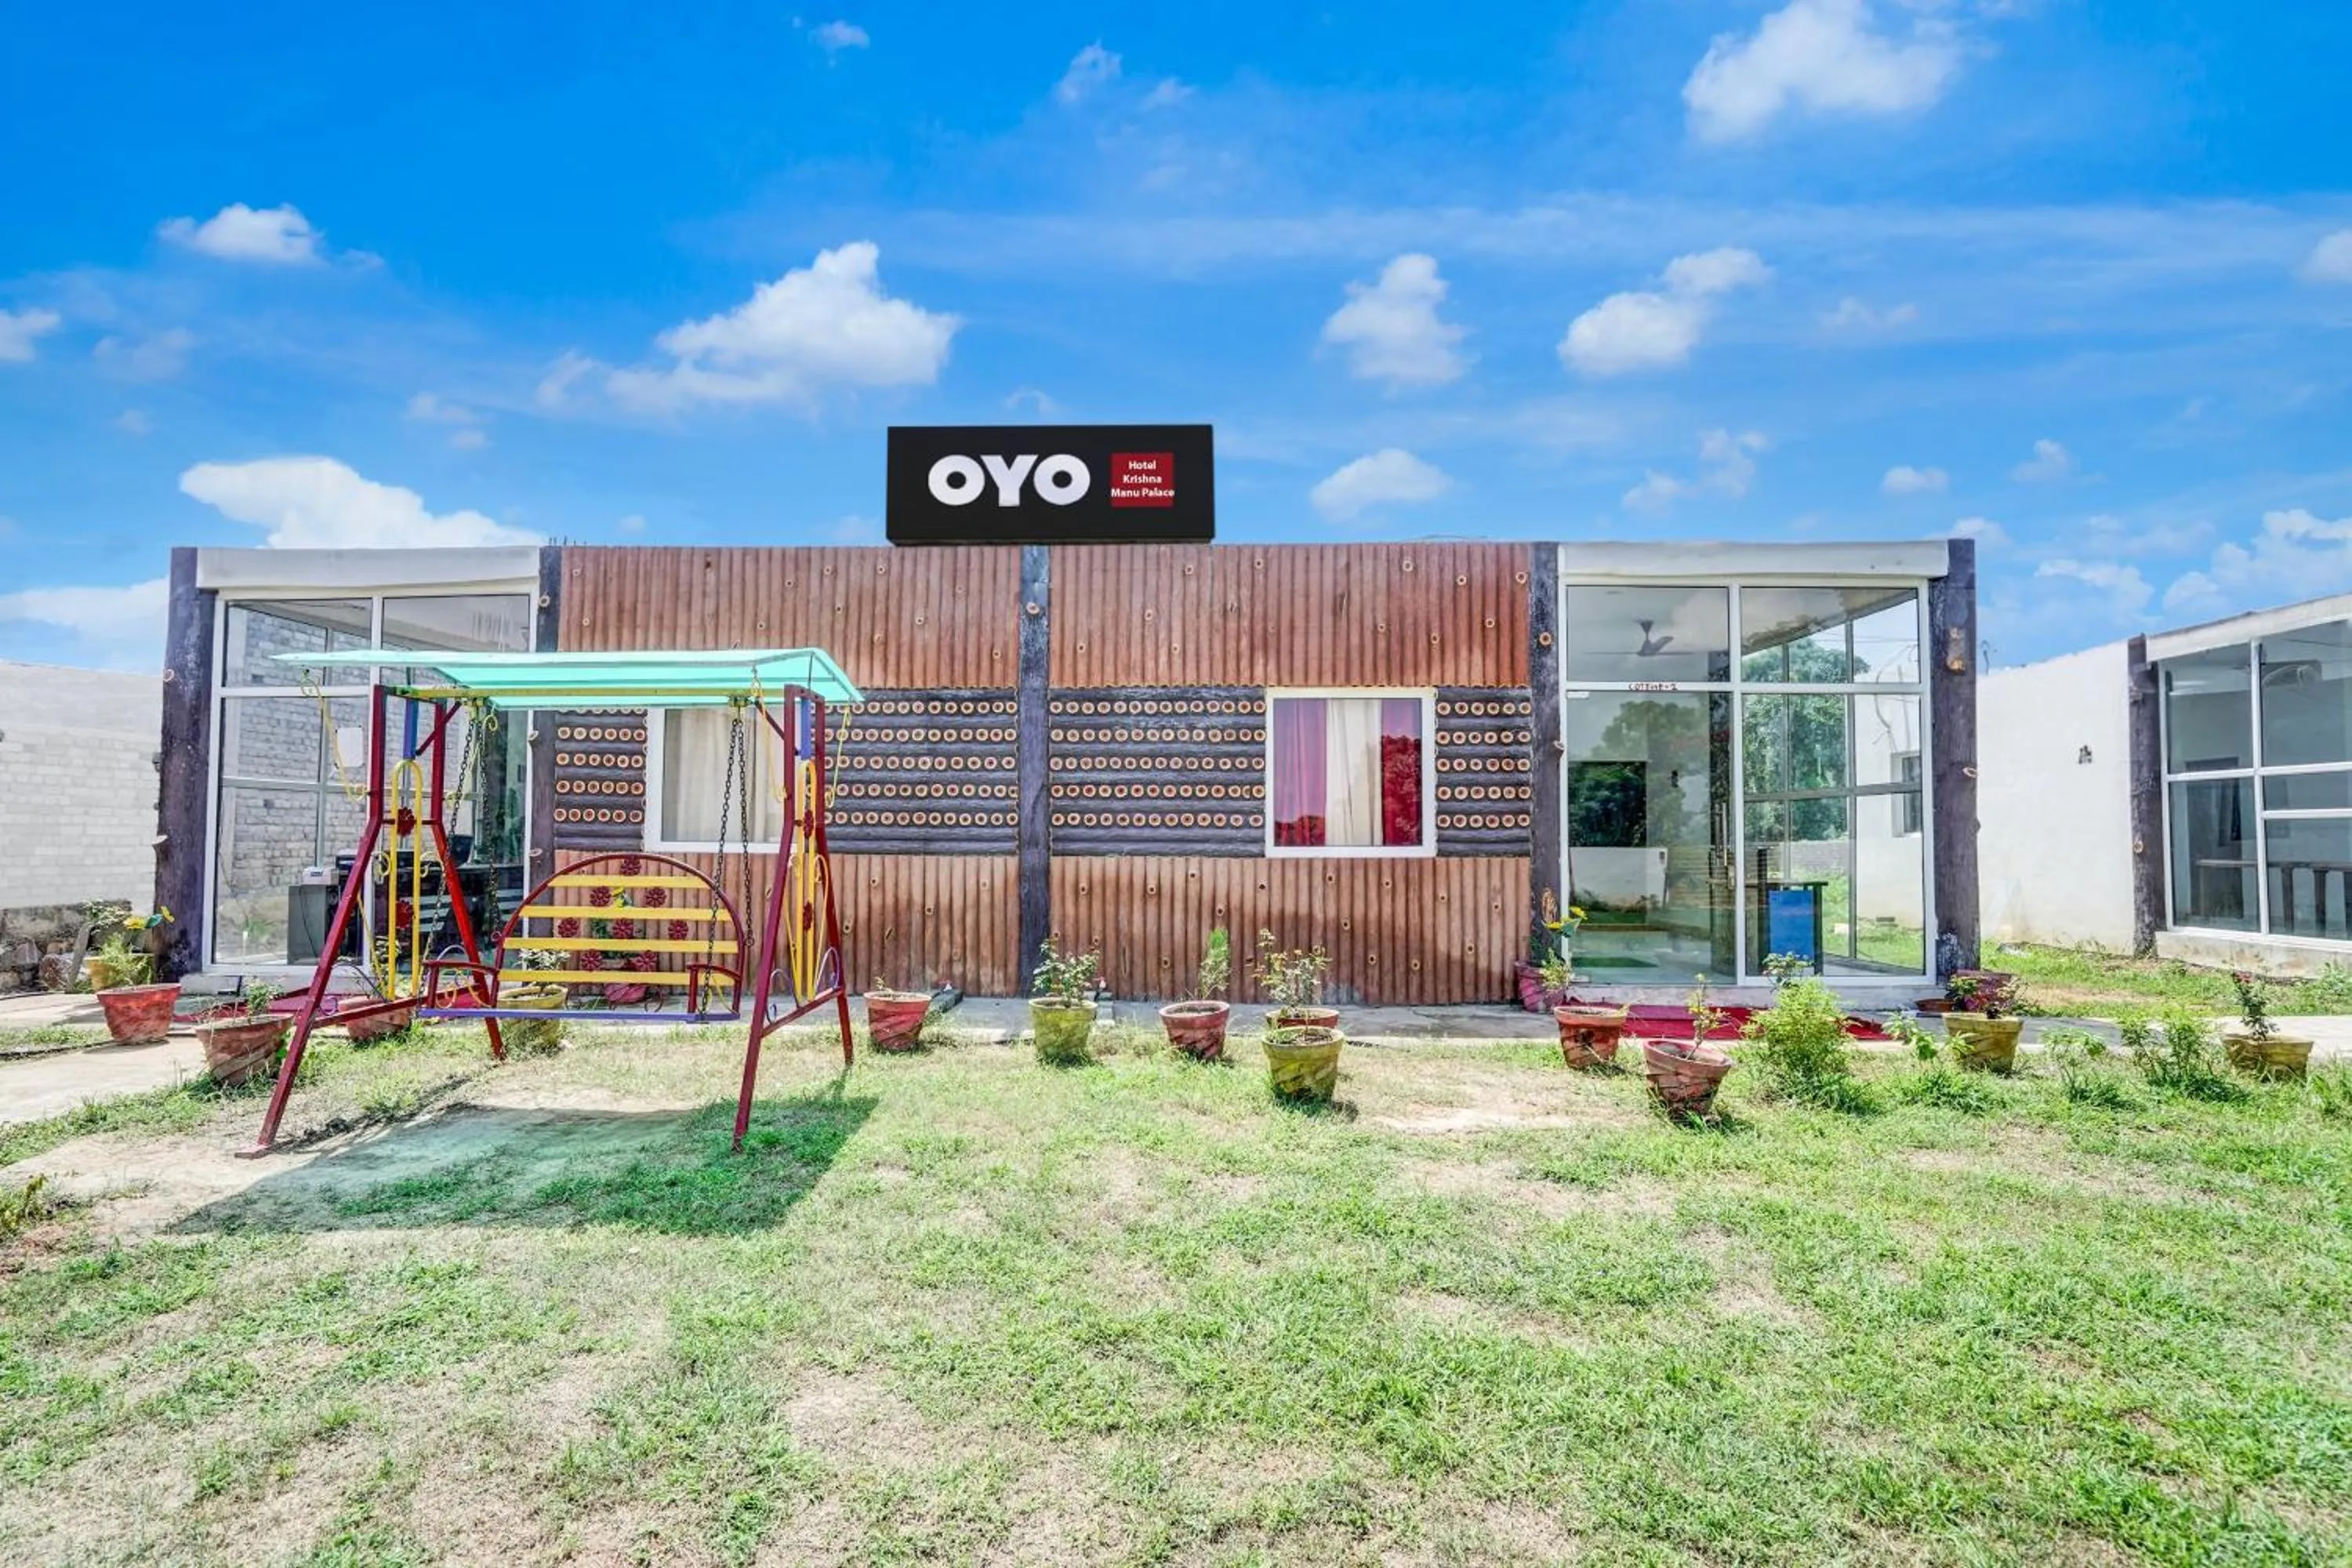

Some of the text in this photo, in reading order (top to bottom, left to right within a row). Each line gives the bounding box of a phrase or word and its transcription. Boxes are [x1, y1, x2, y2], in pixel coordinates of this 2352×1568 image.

[1128, 459, 1156, 470] Hotel
[928, 454, 1091, 507] OYO
[1123, 474, 1163, 484] Krishna
[1111, 487, 1175, 498] Manu Palace
